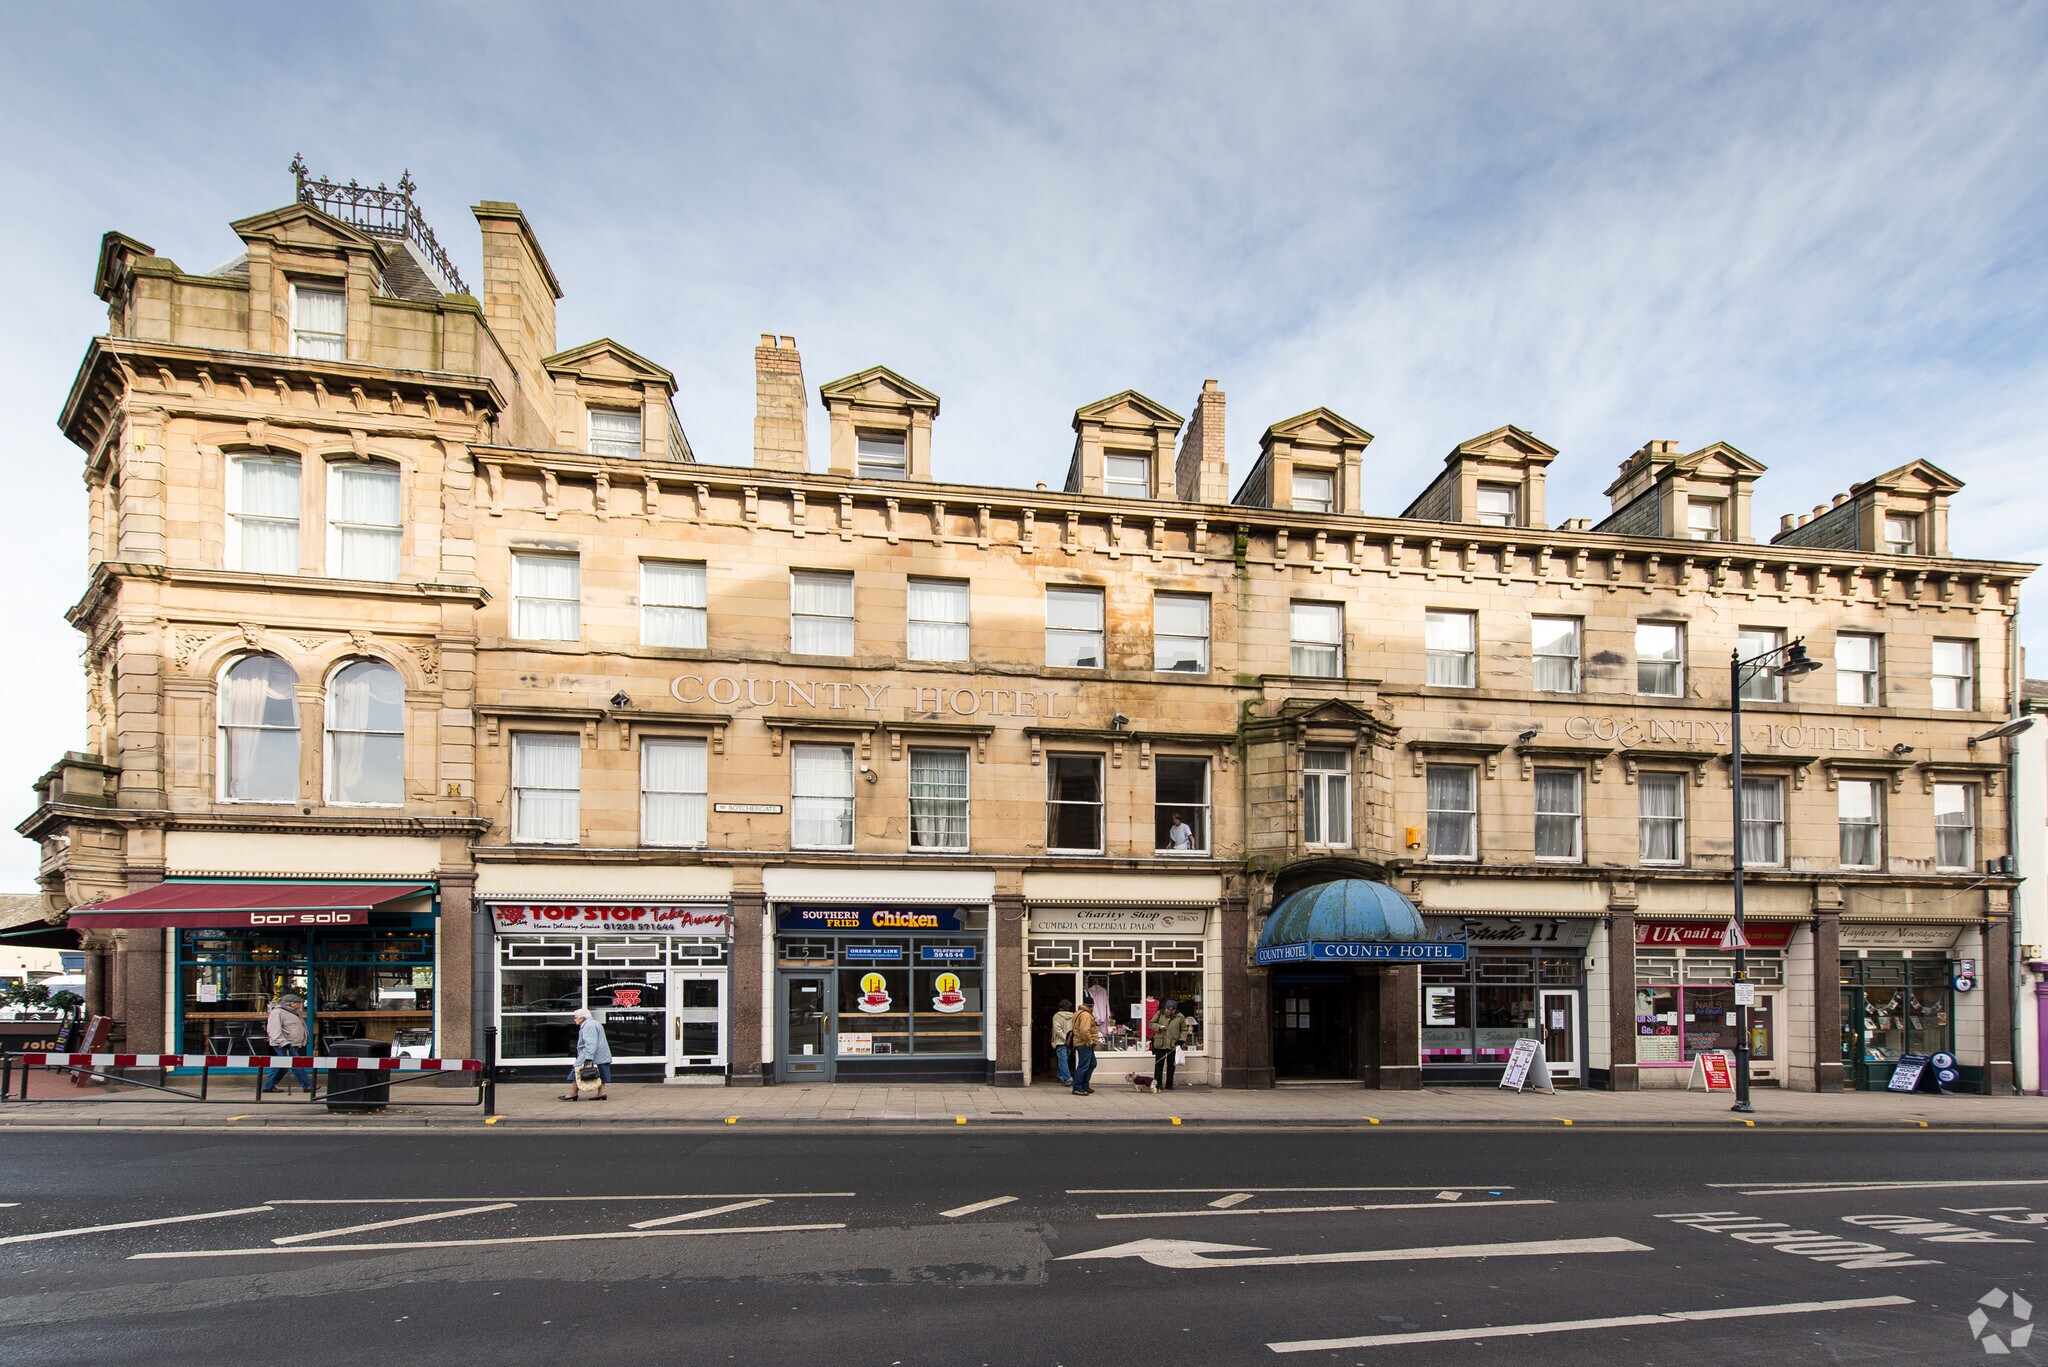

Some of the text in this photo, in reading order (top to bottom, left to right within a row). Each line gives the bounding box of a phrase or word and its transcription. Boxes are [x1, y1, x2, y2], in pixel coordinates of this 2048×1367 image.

[670, 674, 1071, 719] COUNTY HOTEL
[1565, 715, 1732, 748] COUNTY
[728, 805, 777, 813] BOTCHERGATE
[250, 911, 351, 924] bar solo
[529, 906, 684, 922] TOP STOP Take
[680, 911, 725, 928] Away
[802, 911, 860, 919] SOUTHERN
[872, 910, 939, 928] Chicken
[1077, 910, 1160, 921] Charity Shop
[826, 919, 860, 927] FRIED
[1038, 921, 1156, 930] CUMBRIA CEREBRAL PALSY
[1447, 921, 1526, 941] Studio
[1530, 923, 1559, 941] 11
[1653, 926, 1724, 942] UK nail ar
[1839, 926, 1954, 940] Hayhurst Newsagents
[802, 947, 810, 958] 5
[1259, 946, 1307, 961] COUNTY HOTEL
[1325, 944, 1452, 957] COUNTY HOTEL
[1695, 1001, 1723, 1009] NAILS
[22, 1040, 56, 1050] solo
[1652, 1211, 1946, 1270] NORTH
